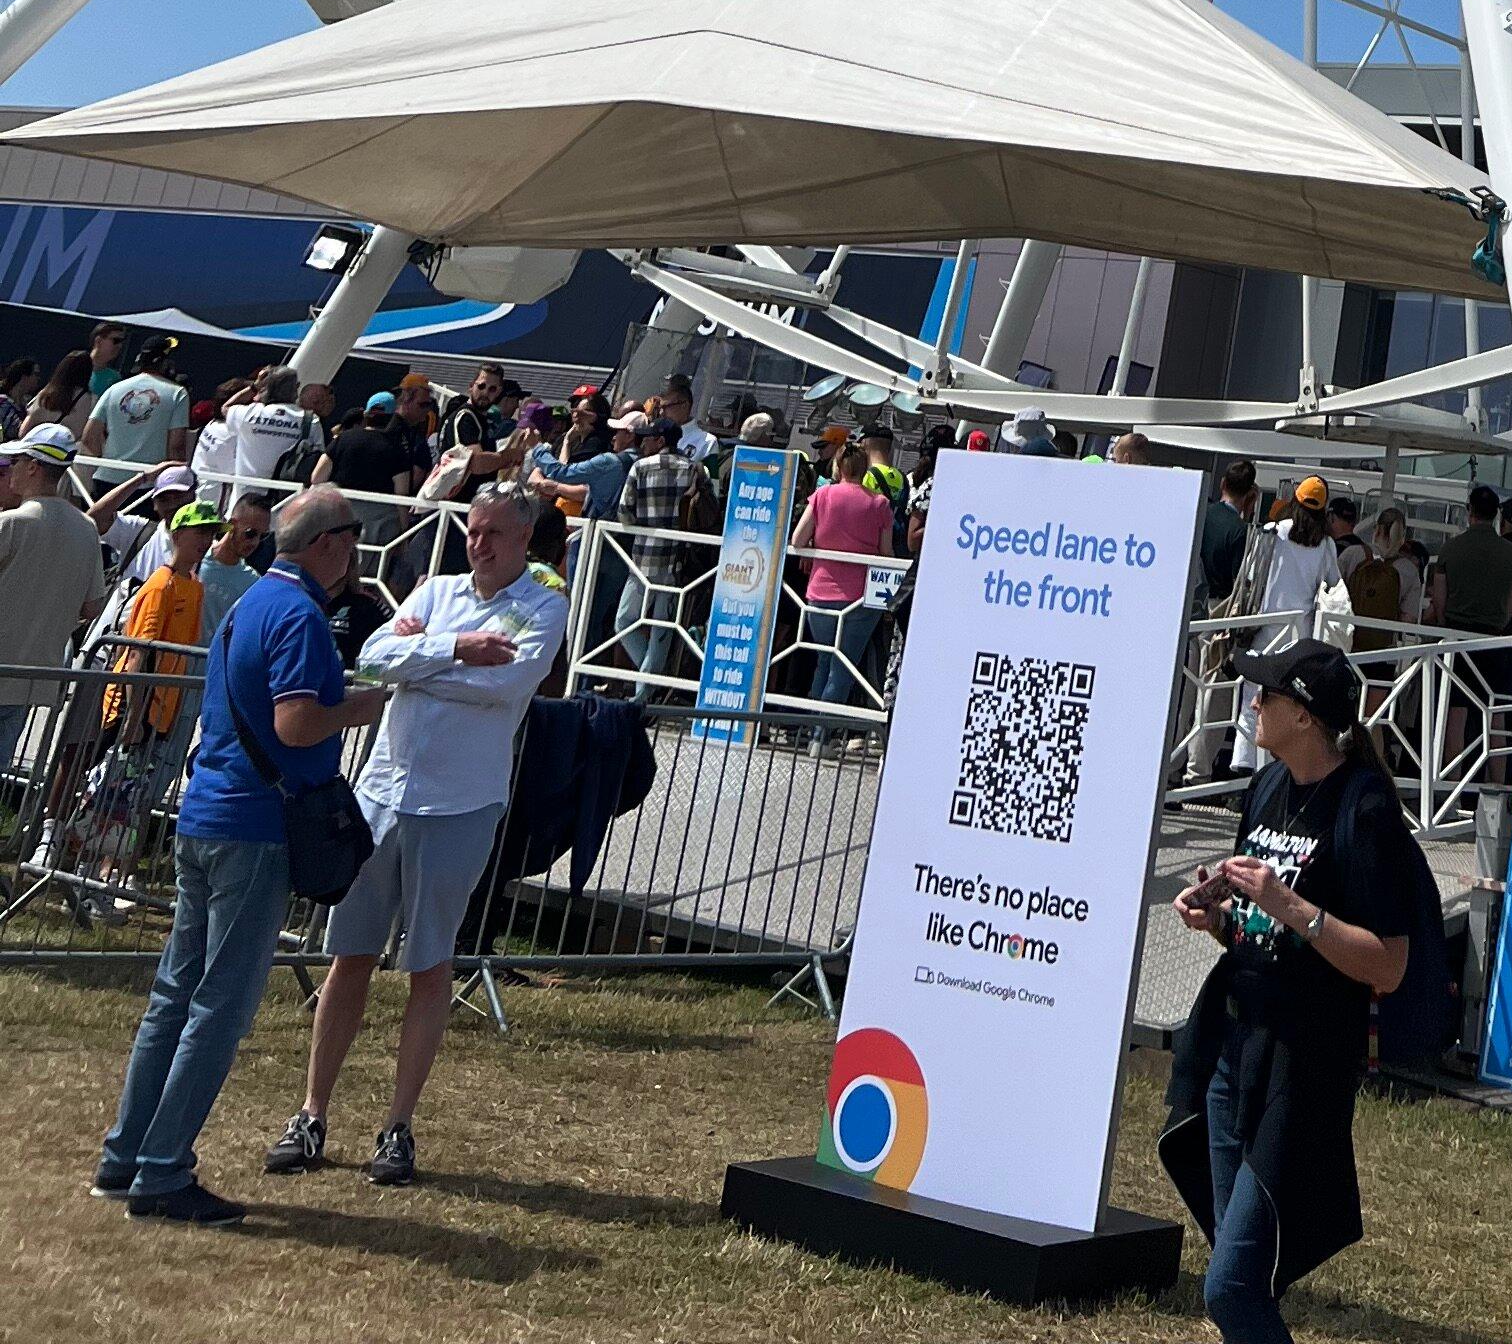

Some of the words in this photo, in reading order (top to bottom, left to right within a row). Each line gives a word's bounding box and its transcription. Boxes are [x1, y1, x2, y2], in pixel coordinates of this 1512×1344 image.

[738, 481, 756, 501] Any
[756, 486, 774, 501] age
[735, 506, 752, 521] can
[752, 506, 771, 523] ride
[742, 525, 758, 542] the
[956, 513, 1051, 560] Speed
[1054, 523, 1117, 564] lane
[1124, 533, 1156, 568] to
[725, 563, 754, 574] GIANT
[870, 570, 891, 584] WAY
[984, 569, 1032, 608] the
[1038, 574, 1112, 617] front
[722, 598, 738, 614] But
[738, 603, 755, 617] you
[717, 623, 740, 639] must
[740, 623, 753, 641] be
[714, 643, 732, 661] this
[733, 646, 749, 663] tall
[713, 666, 724, 683] to
[723, 667, 743, 686] ride
[704, 688, 745, 709] WITHOUT
[915, 863, 991, 904] There's
[995, 885, 1024, 909] no
[1026, 885, 1089, 921] place
[926, 912, 964, 946] like
[968, 920, 1059, 964] Chrome
[937, 971, 982, 992] Download
[983, 981, 1016, 1001] Google
[1018, 988, 1055, 1007] Chrome
